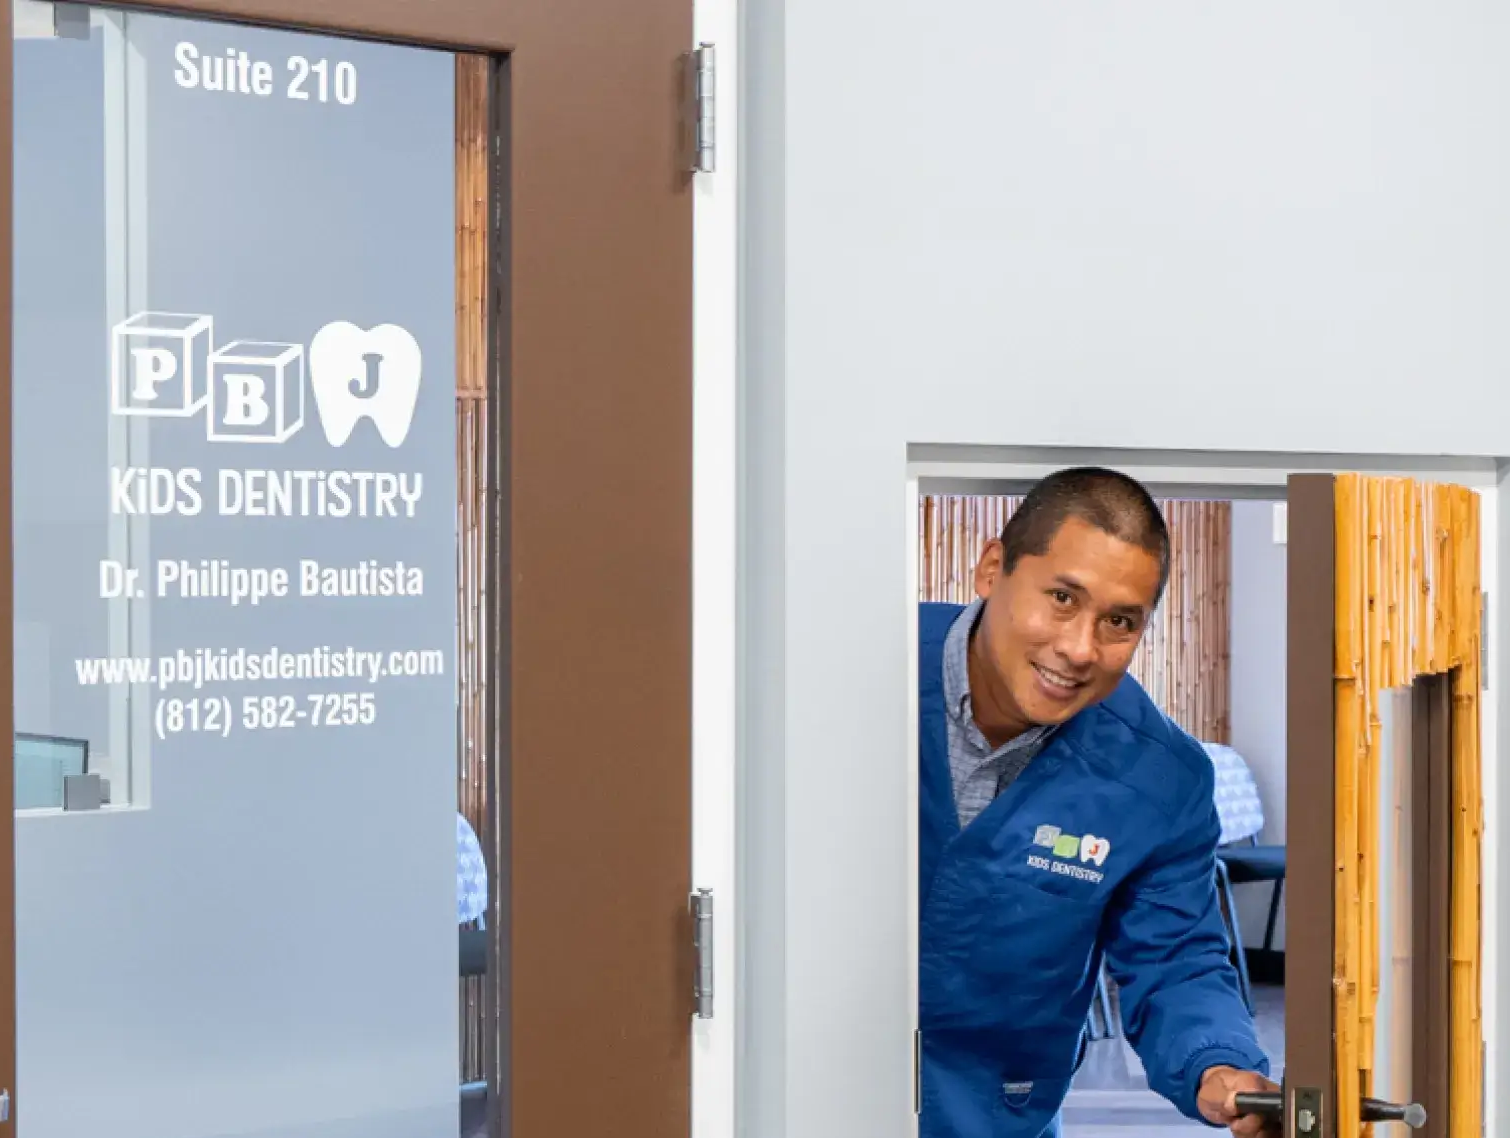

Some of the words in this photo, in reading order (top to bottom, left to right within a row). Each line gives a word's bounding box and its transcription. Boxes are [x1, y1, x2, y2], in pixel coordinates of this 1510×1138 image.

[174, 41, 273, 97] Suite
[286, 55, 357, 105] 210
[99, 560, 145, 599] Dr.
[157, 560, 289, 606] Philippe
[300, 559, 424, 597] Bautista
[75, 646, 444, 690] www.pbjkidsdentistry.com
[155, 696, 232, 739] (812)
[242, 693, 376, 729] 582-7255
